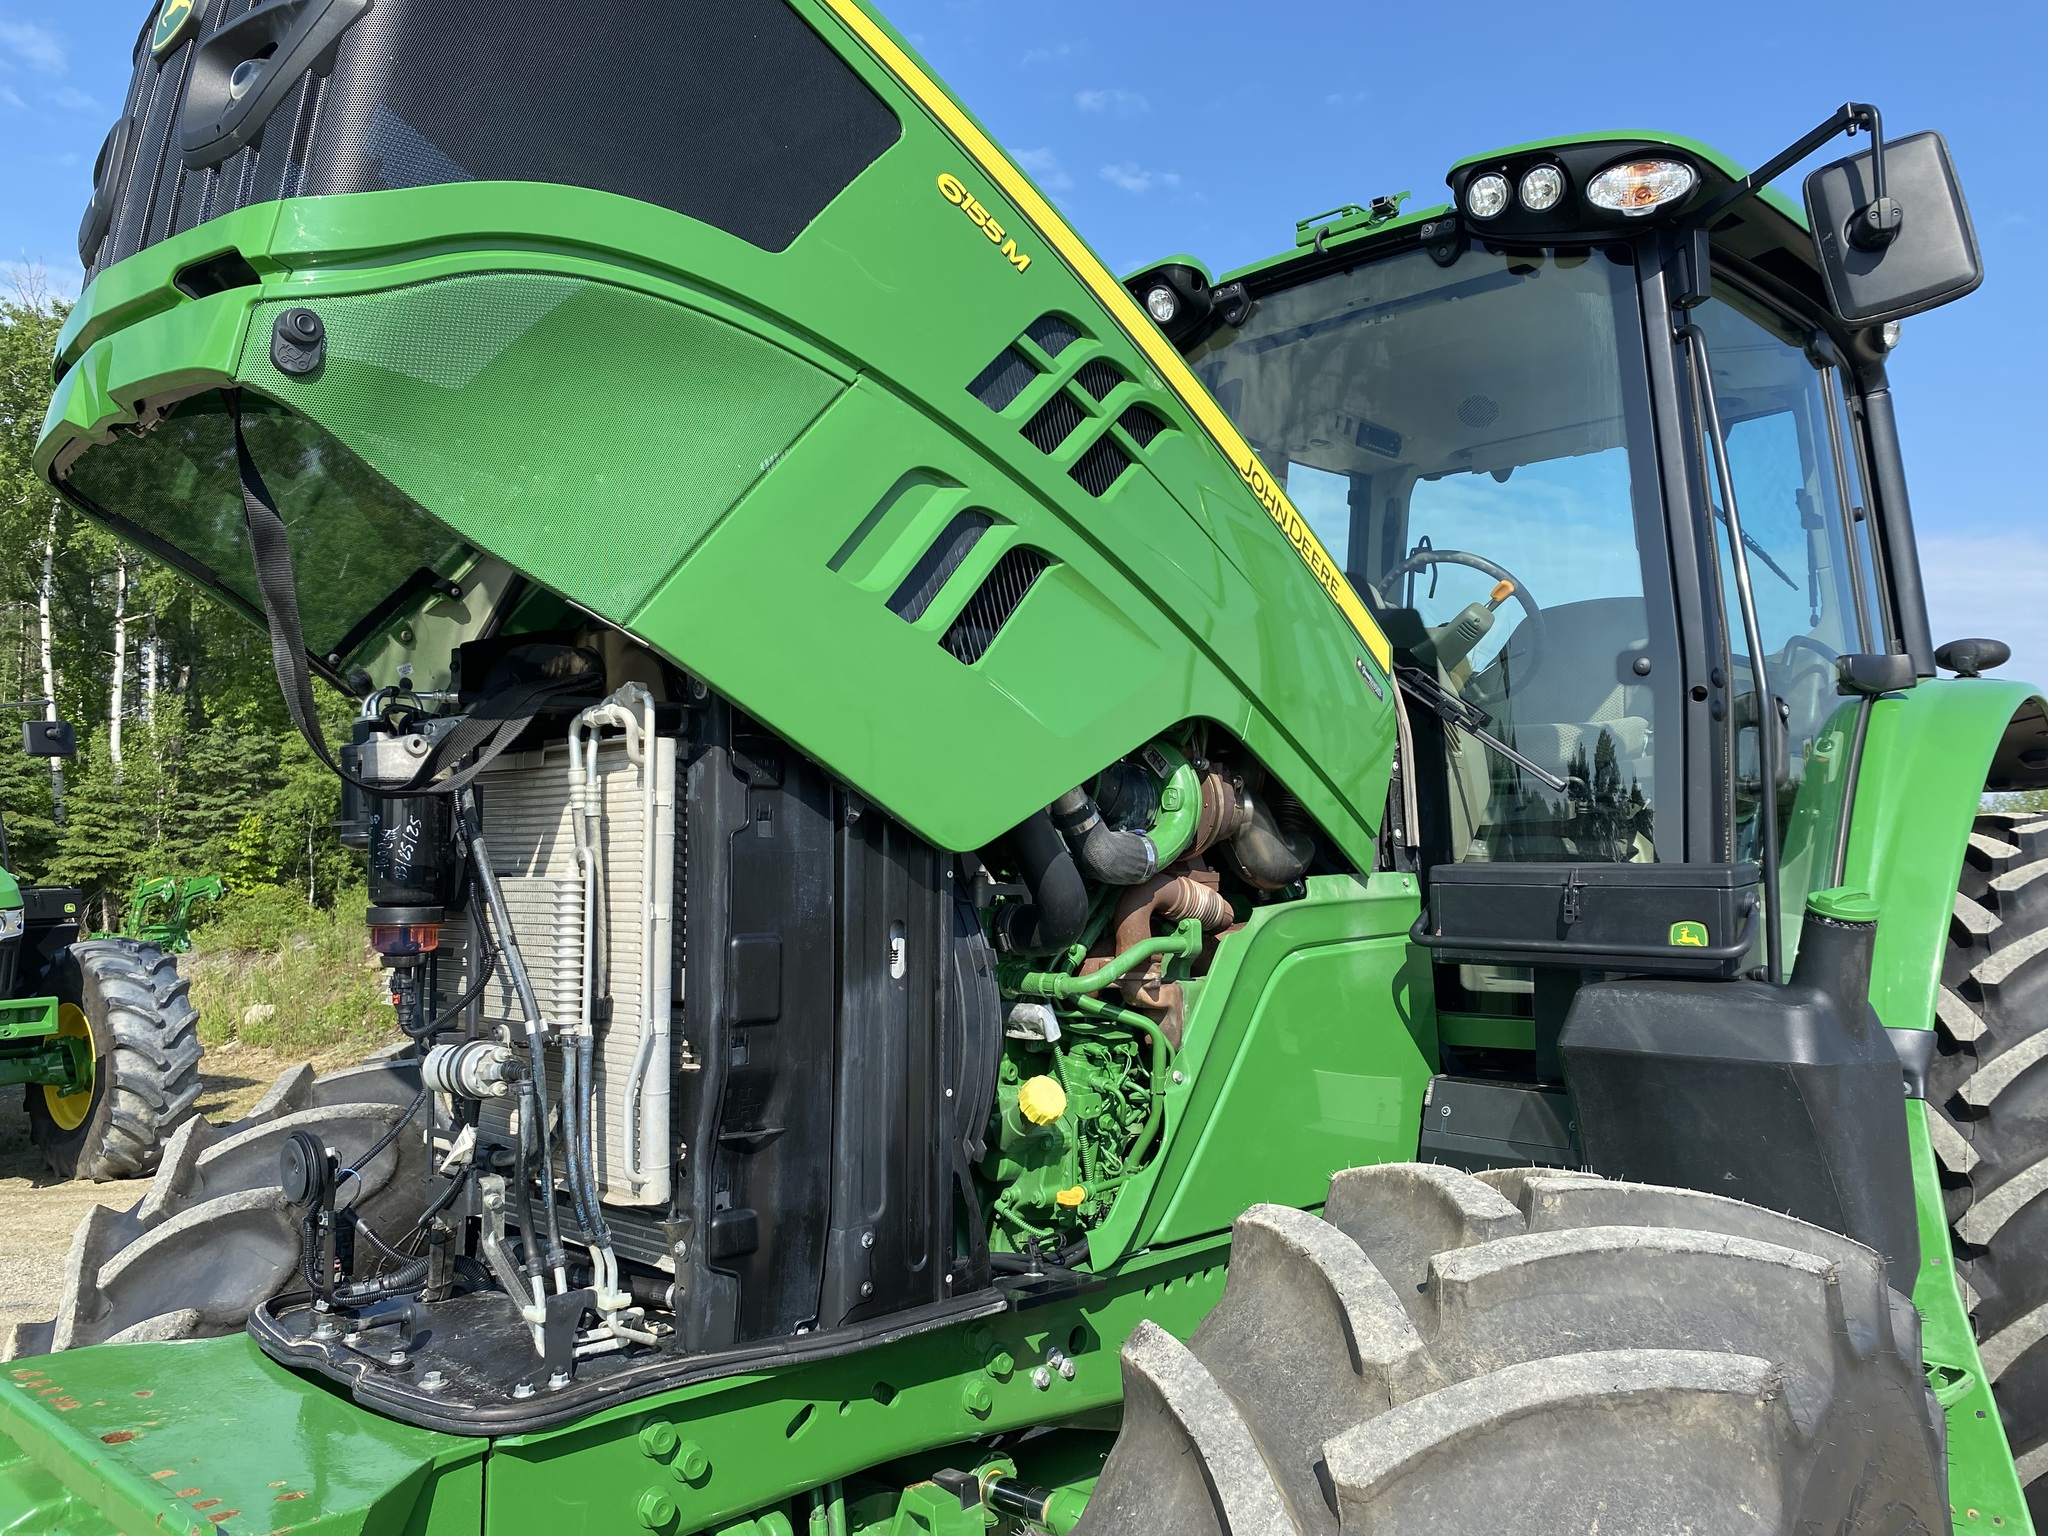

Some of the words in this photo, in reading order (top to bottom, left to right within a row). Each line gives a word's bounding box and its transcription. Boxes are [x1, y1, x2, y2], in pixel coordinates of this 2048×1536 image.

[937, 173, 1007, 245] 6155
[1240, 459, 1288, 527] JOHN
[1288, 515, 1340, 600] DEERE
